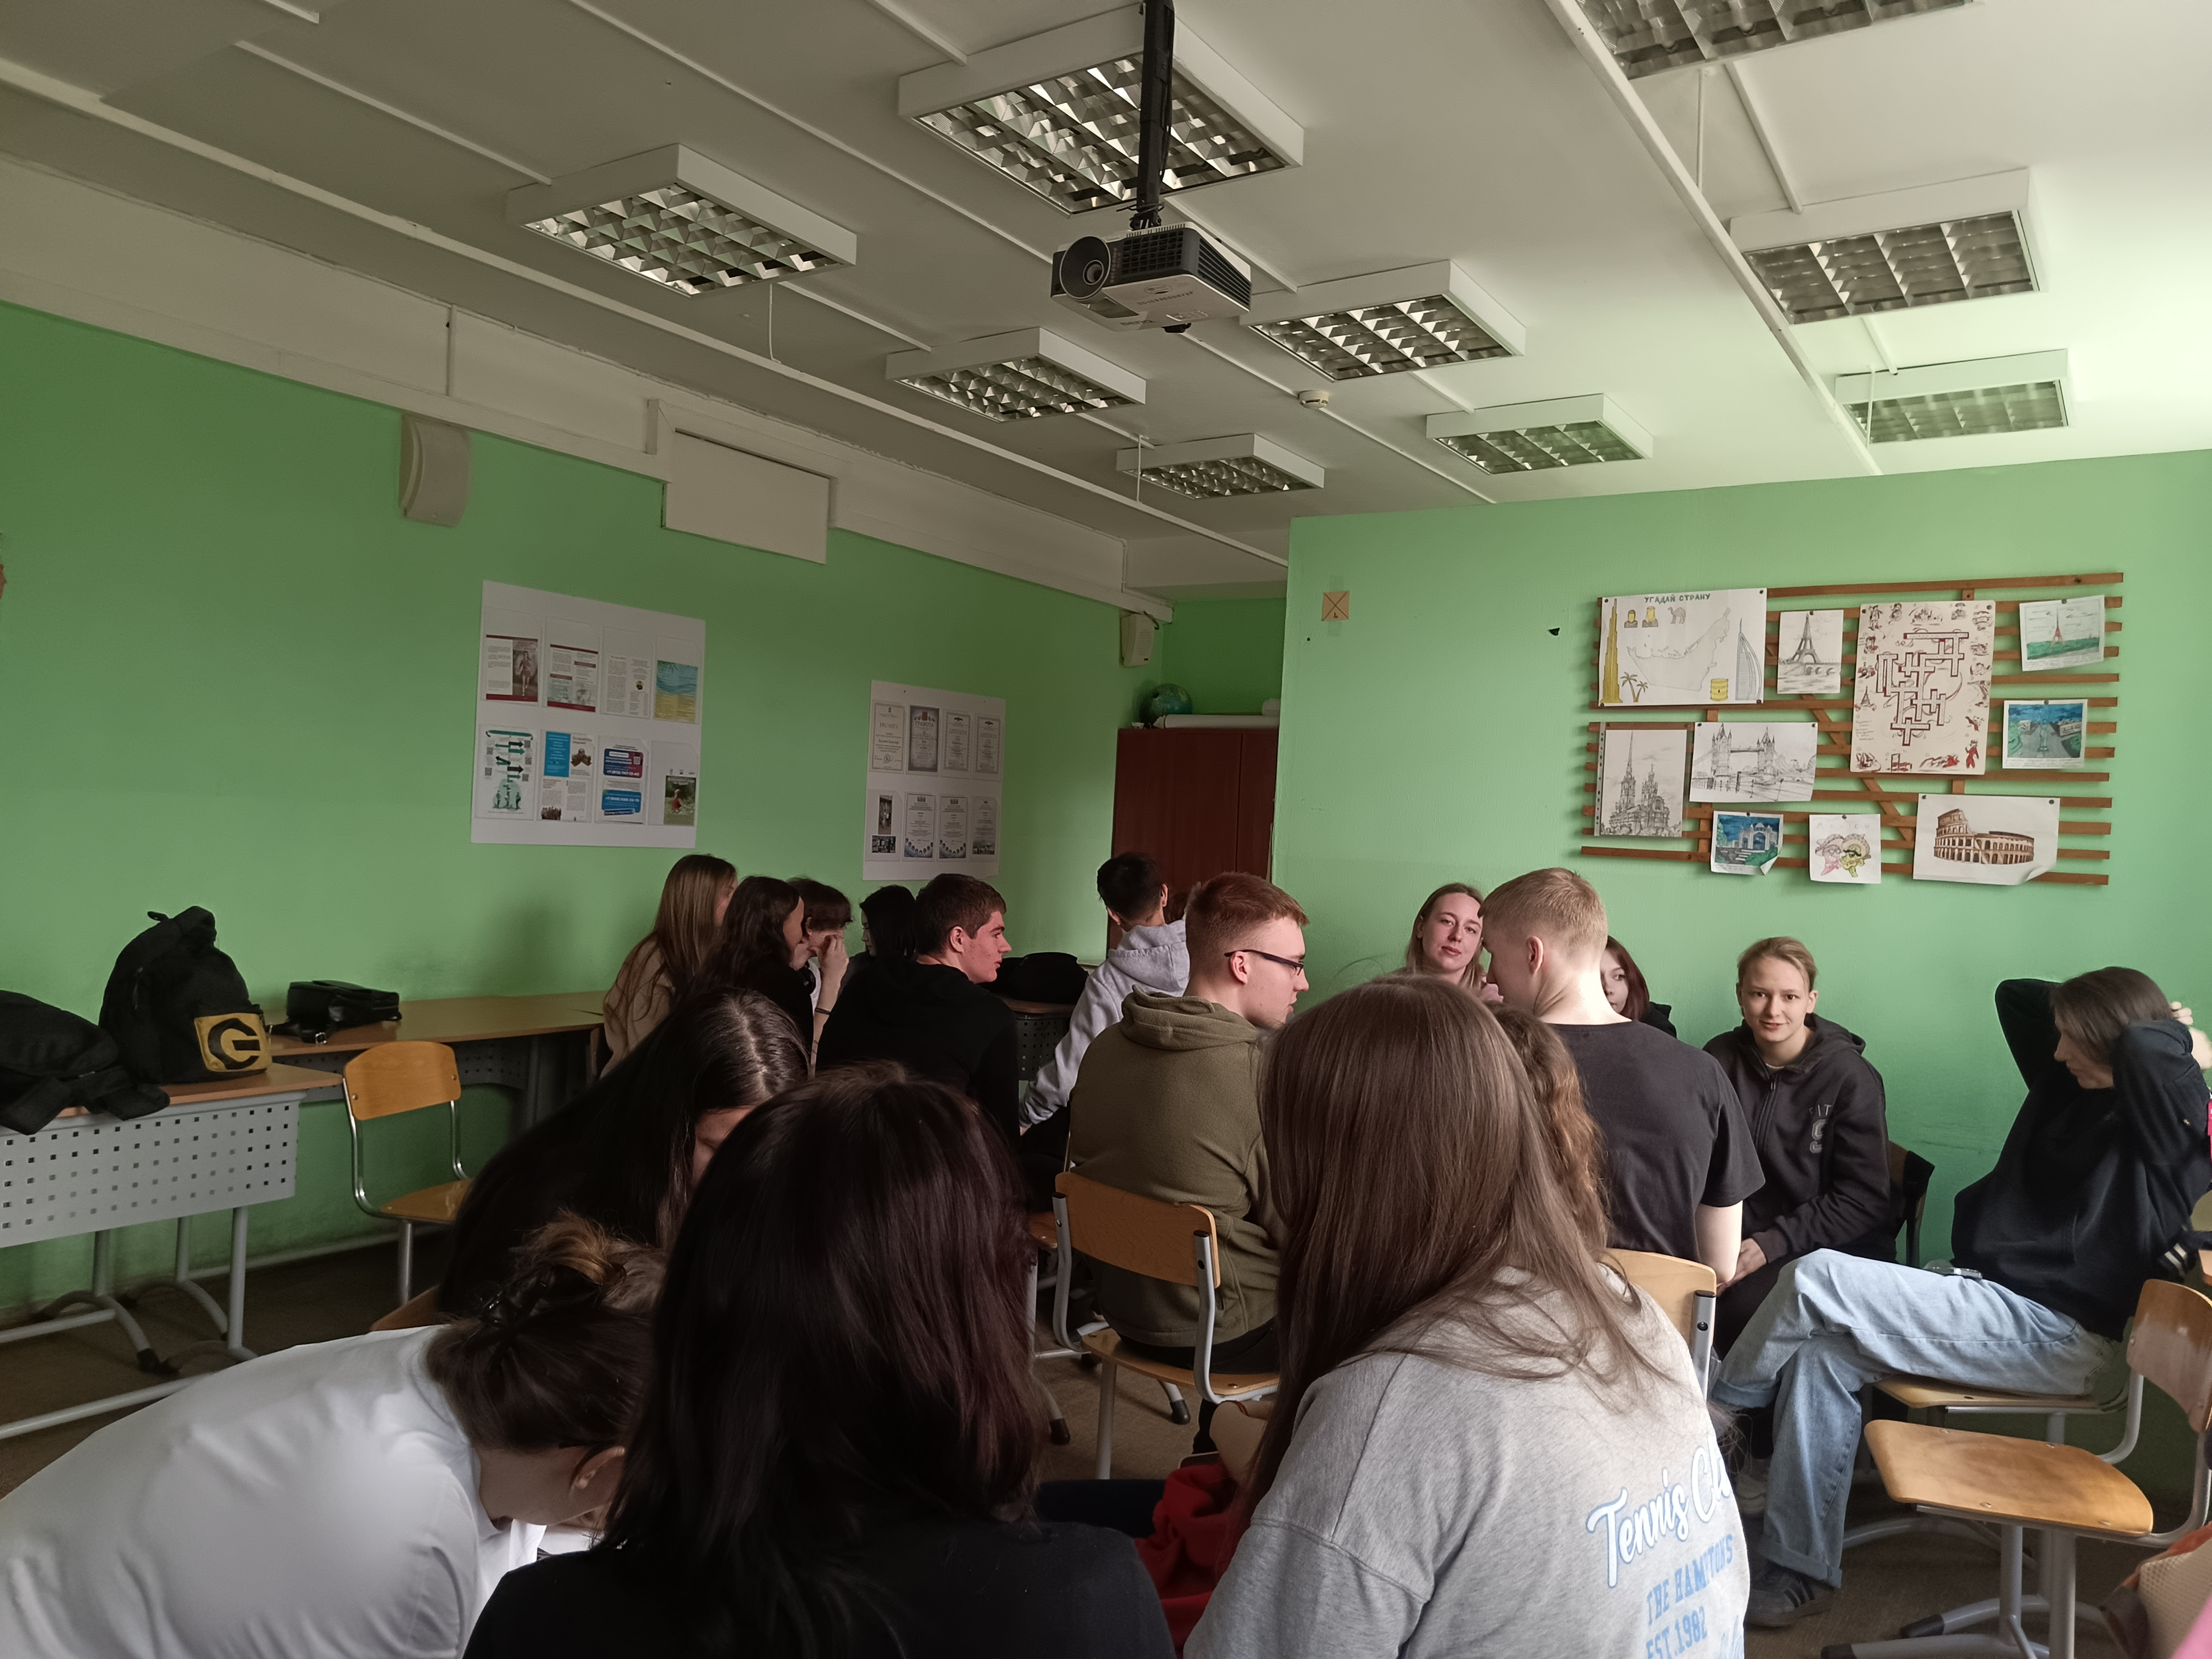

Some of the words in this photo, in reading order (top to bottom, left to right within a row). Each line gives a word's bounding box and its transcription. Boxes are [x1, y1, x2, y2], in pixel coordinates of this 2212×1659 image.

[1644, 594, 1676, 604] УГАДАЙ
[1679, 593, 1711, 601] СТРАНУ
[1586, 1467, 1689, 1587] Tennis
[1646, 1578, 1670, 1625] THE
[1674, 1534, 1733, 1603] HAMPTONS
